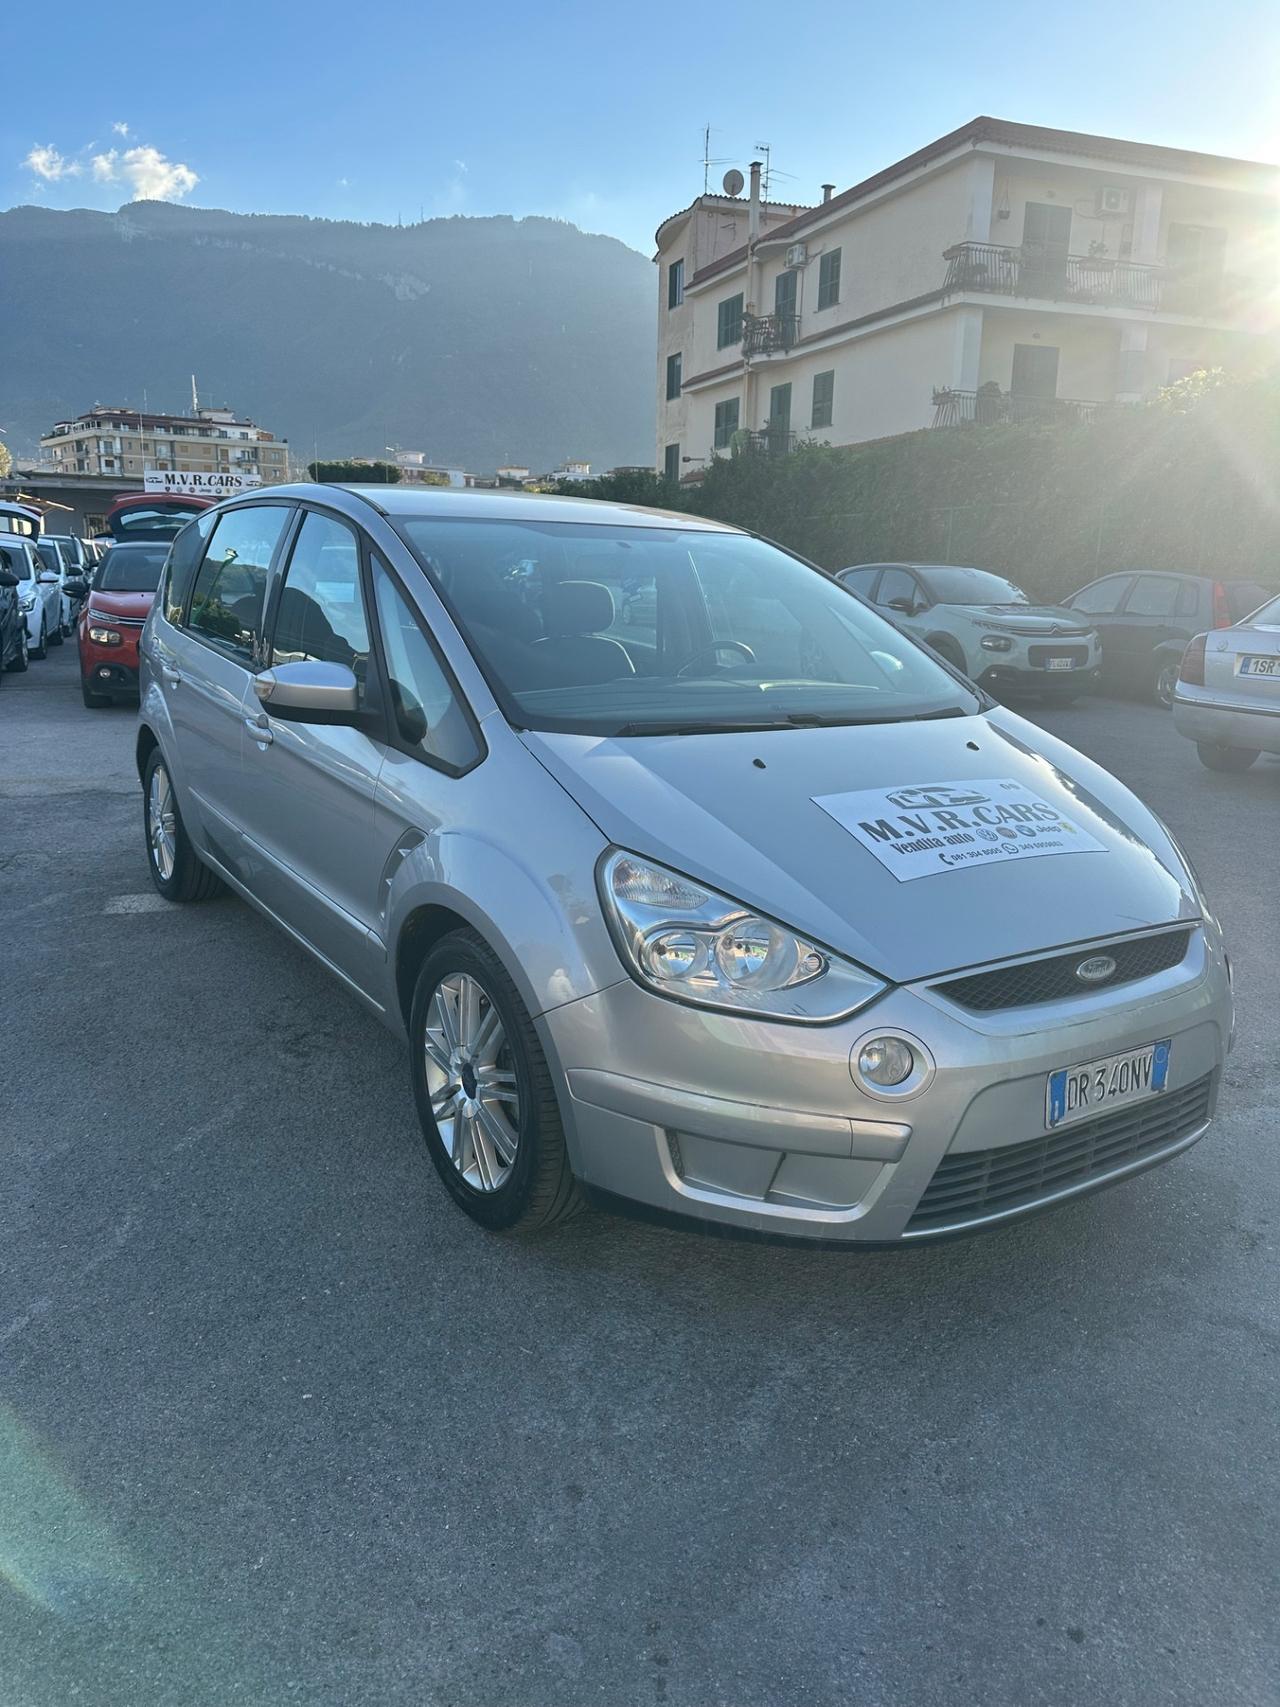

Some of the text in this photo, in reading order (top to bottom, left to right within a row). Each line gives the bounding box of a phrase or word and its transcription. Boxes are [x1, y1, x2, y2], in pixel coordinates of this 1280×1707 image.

[164, 473, 242, 487] M.V.R.CARS
[1253, 660, 1275, 673] 1SR
[857, 802, 1060, 843] M.V.R.CARS
[889, 832, 975, 855] Vendita auto
[1068, 1073, 1089, 1111] DR
[1094, 1055, 1153, 1101] 340NV
